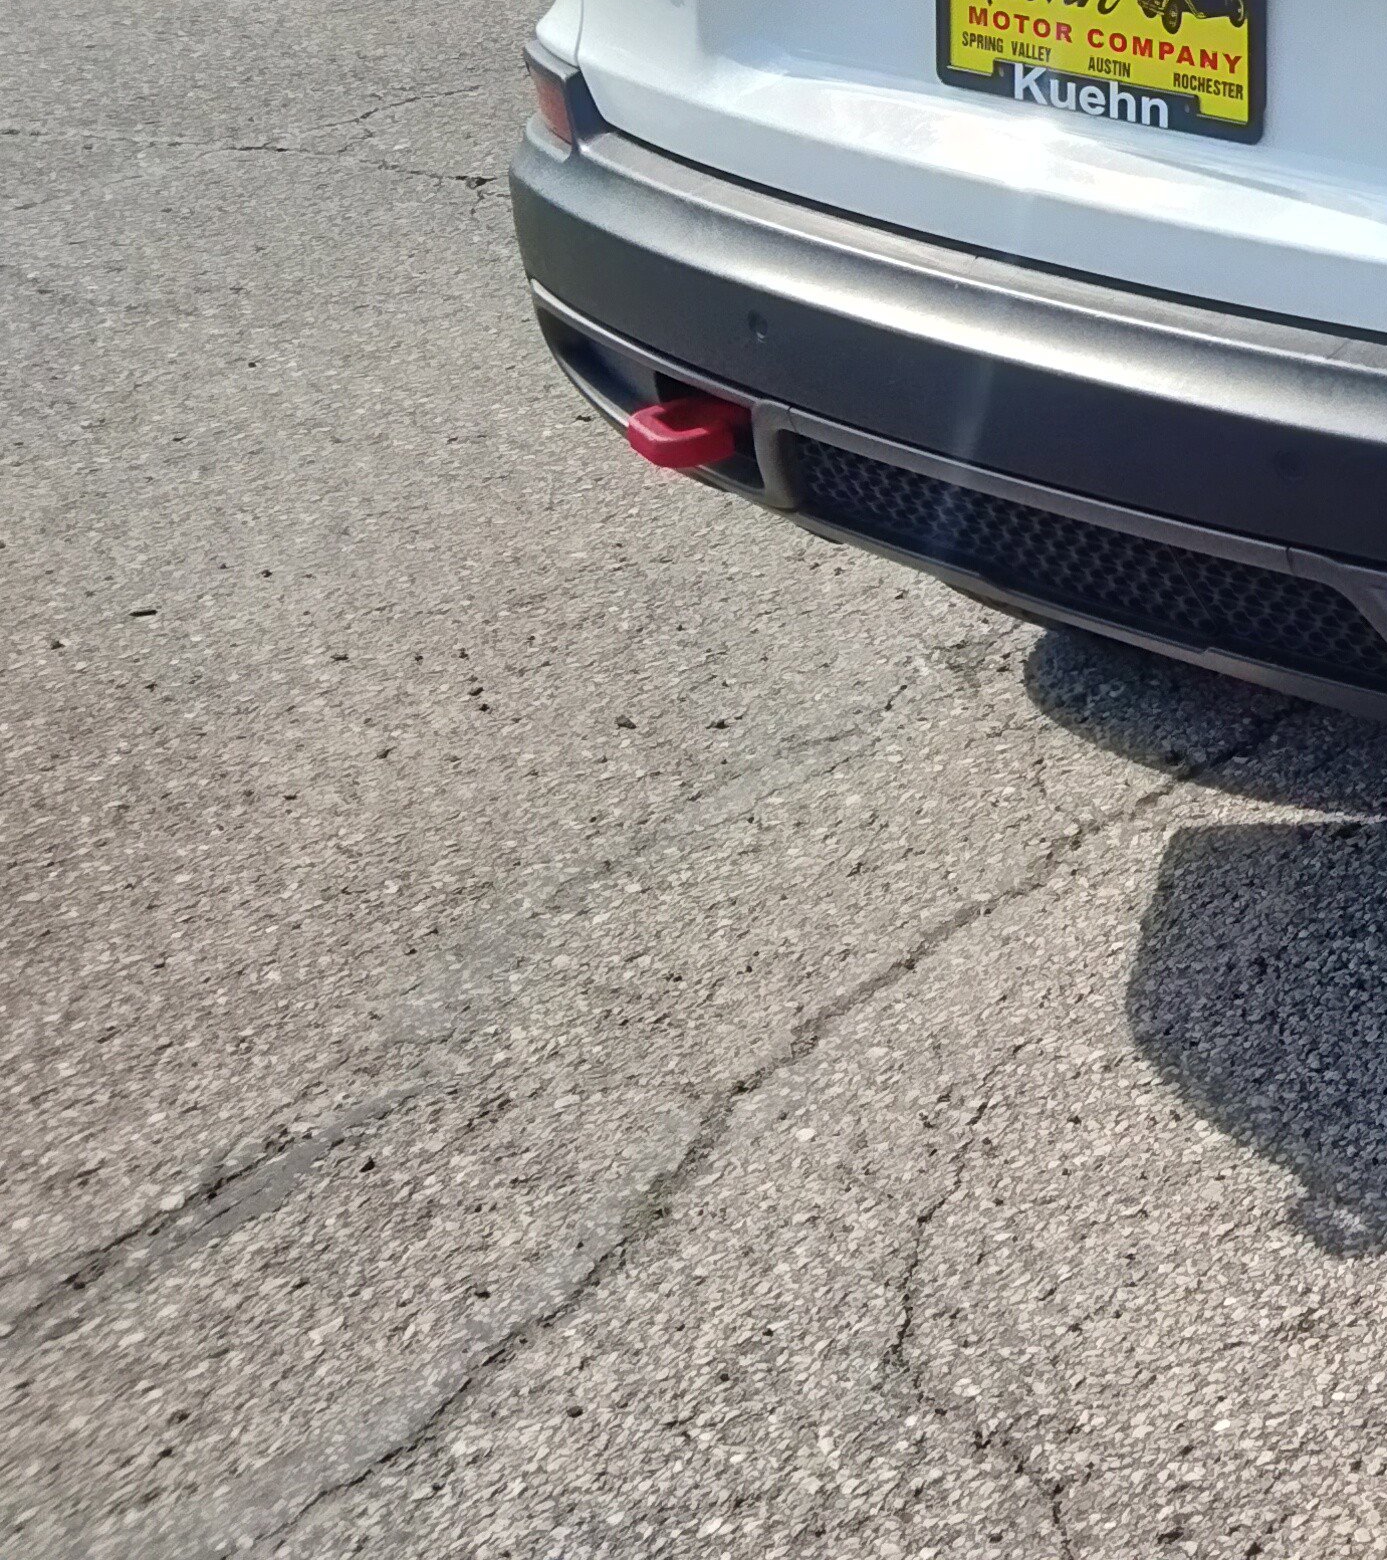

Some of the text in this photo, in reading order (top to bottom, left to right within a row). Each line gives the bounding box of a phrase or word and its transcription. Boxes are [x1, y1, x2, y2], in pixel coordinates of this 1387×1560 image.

[962, 31, 1244, 101] SPRING VALLEY AUSTIN ROCHESTER
[968, 5, 1244, 75] MOTOR COMPANY
[1013, 62, 1169, 128] Kuehn
